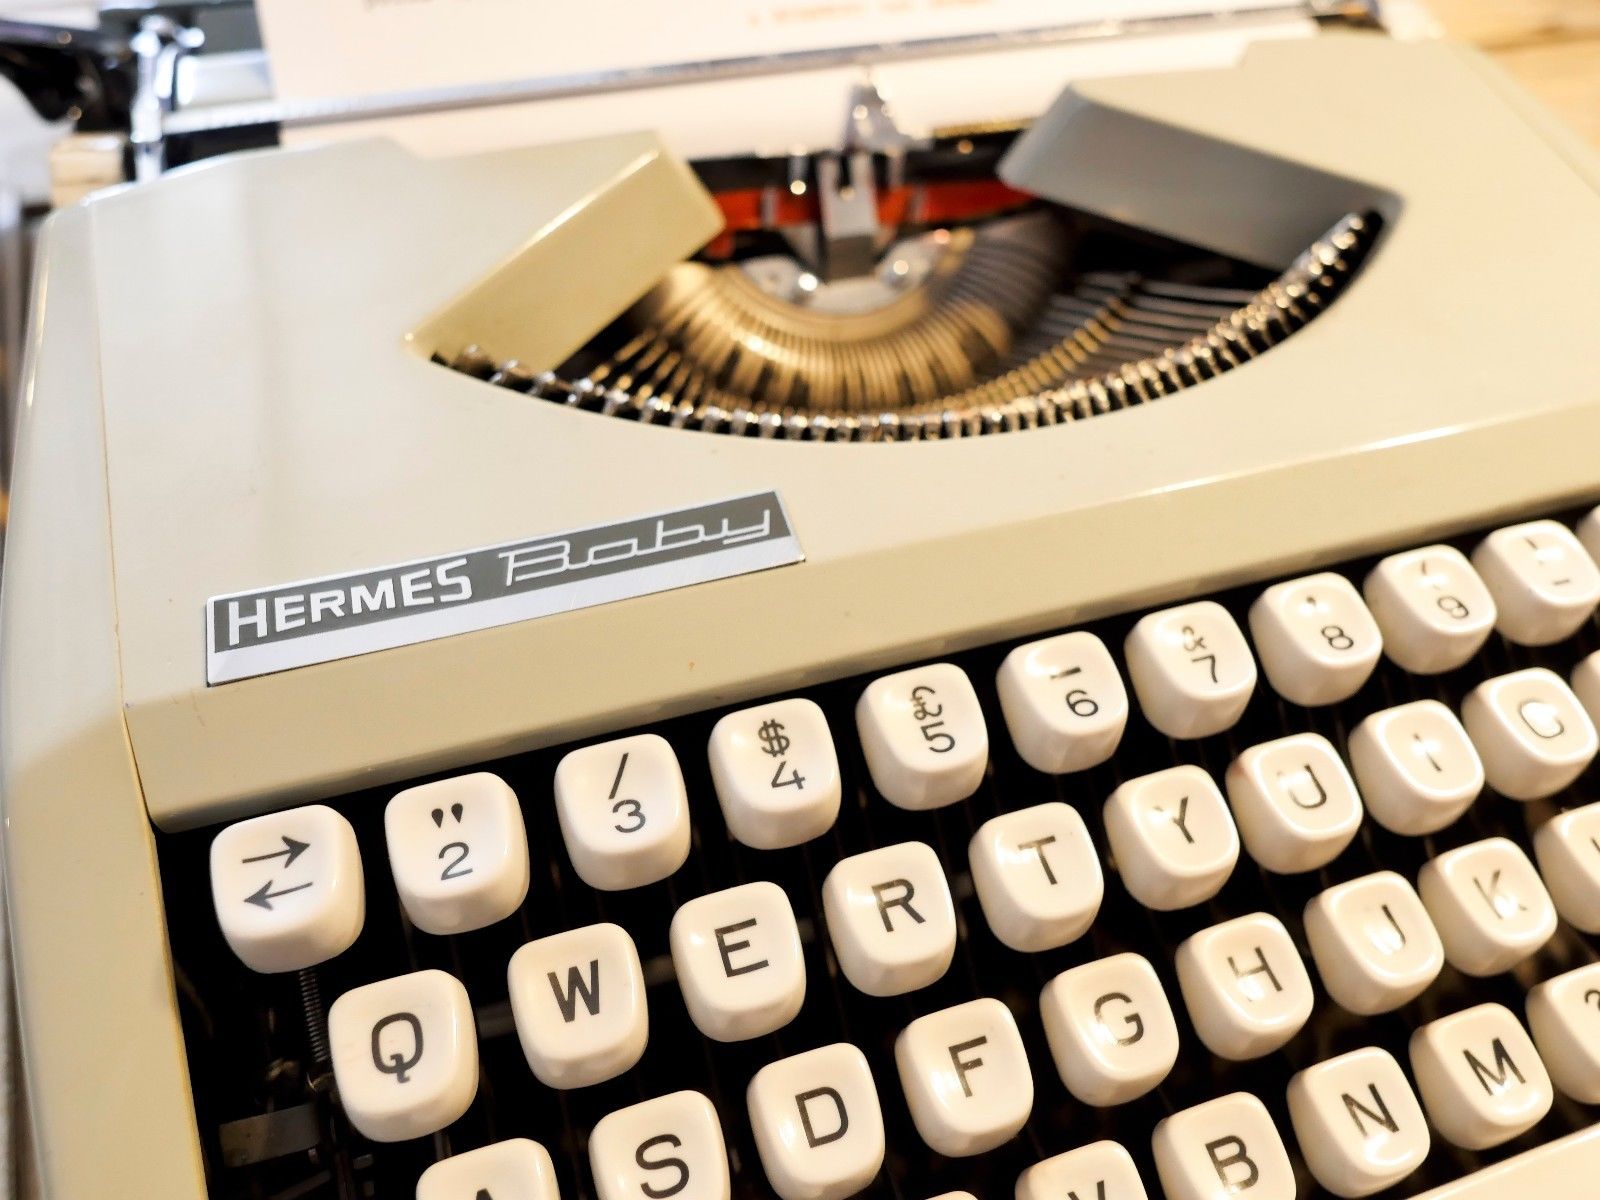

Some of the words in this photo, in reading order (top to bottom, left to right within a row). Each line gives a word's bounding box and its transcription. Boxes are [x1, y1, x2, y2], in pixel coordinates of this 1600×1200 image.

[229, 558, 473, 645] HERMES
[499, 509, 770, 586] Baby
[1437, 596, 1469, 619] 9
[1321, 625, 1354, 650] 8
[1192, 655, 1217, 683] 7
[911, 686, 942, 720] £
[1065, 689, 1099, 717] 6
[758, 719, 790, 757] $
[921, 721, 955, 753] 5
[771, 761, 806, 790] 4
[612, 799, 646, 833] 3
[1154, 796, 1196, 844] Y
[438, 842, 473, 880] 2
[1018, 835, 1058, 886] T
[871, 878, 926, 933] R
[1473, 870, 1528, 920] K
[714, 918, 769, 978] E
[1227, 947, 1283, 1002] H
[547, 959, 601, 1023] W
[1093, 991, 1145, 1047] G
[371, 1012, 424, 1083] Q
[948, 1035, 988, 1098] F
[1463, 1037, 1526, 1096] M
[794, 1086, 849, 1149] D
[1341, 1083, 1400, 1138] N
[635, 1134, 690, 1199] S
[1205, 1135, 1259, 1193] B
